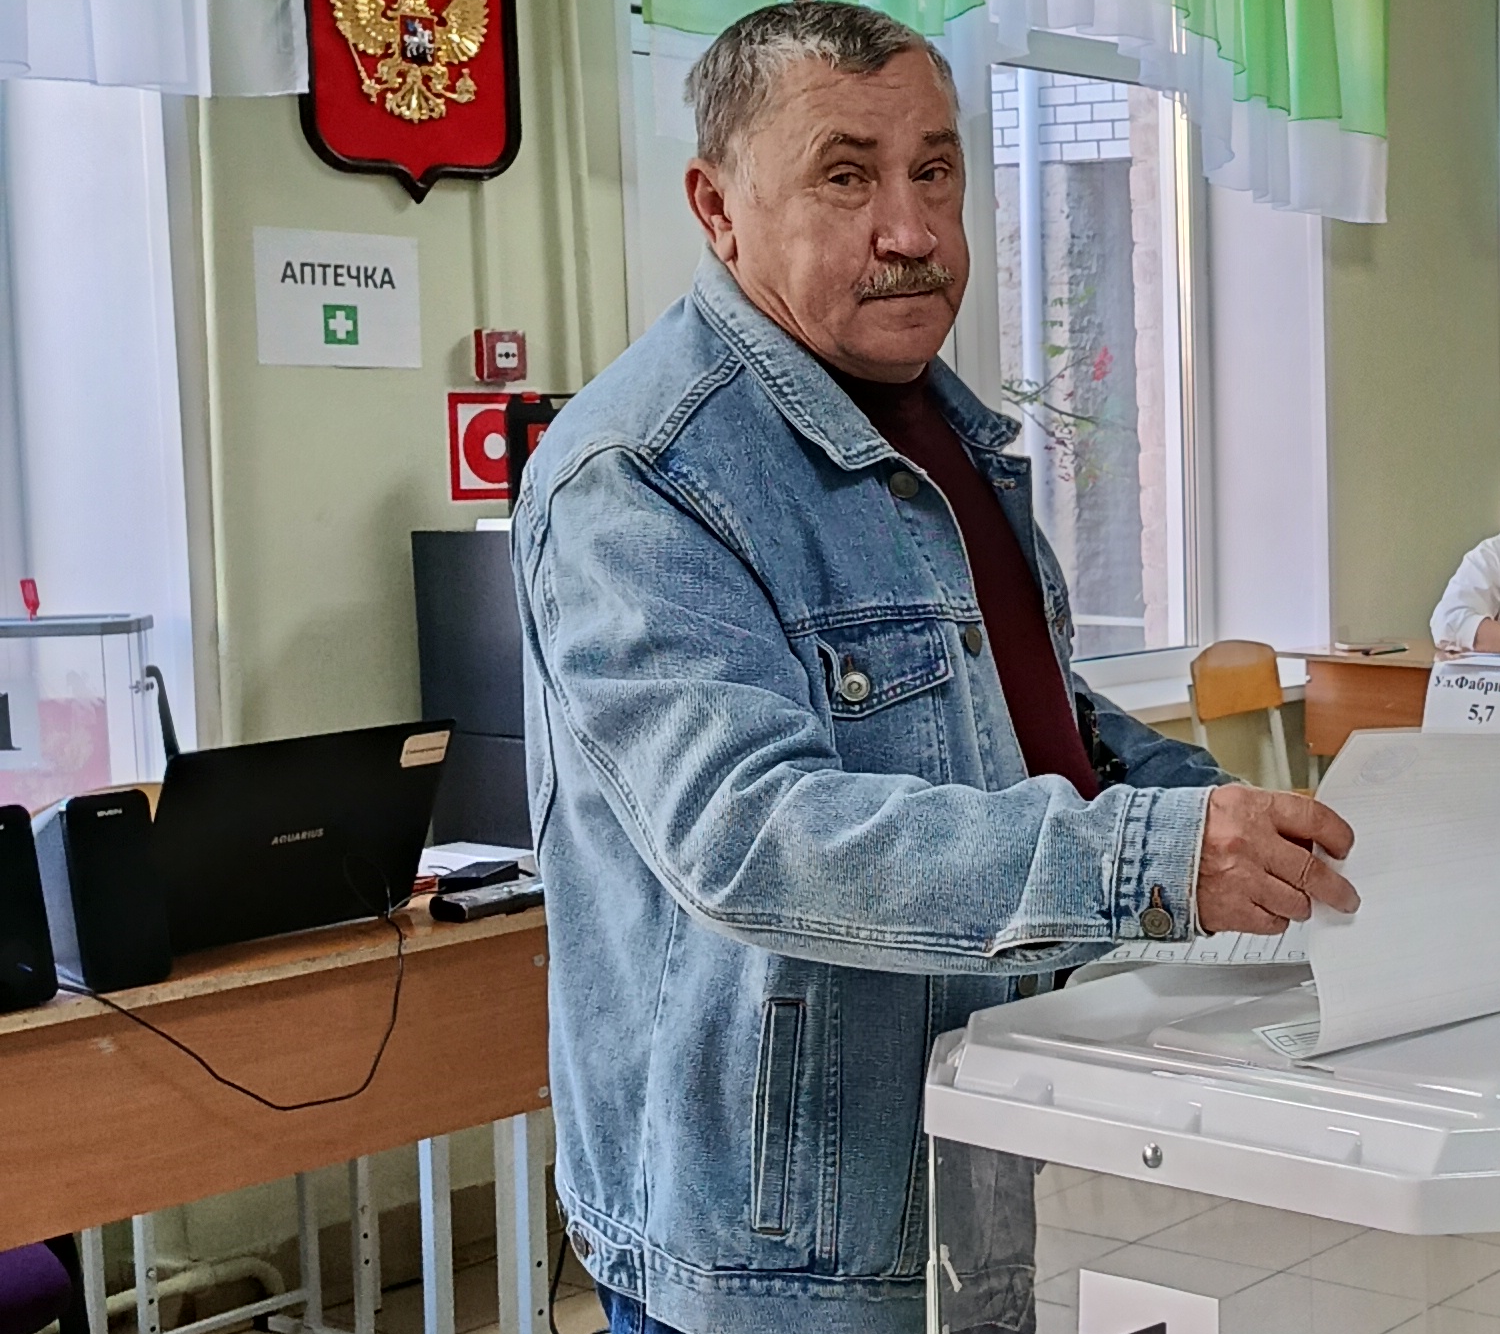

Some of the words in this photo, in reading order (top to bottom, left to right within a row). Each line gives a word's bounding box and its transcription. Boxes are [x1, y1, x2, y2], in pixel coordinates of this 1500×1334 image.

[280, 260, 396, 290] АПТЕЧКА
[1467, 703, 1496, 725] 5,7
[271, 827, 325, 846] AQUARIUS
